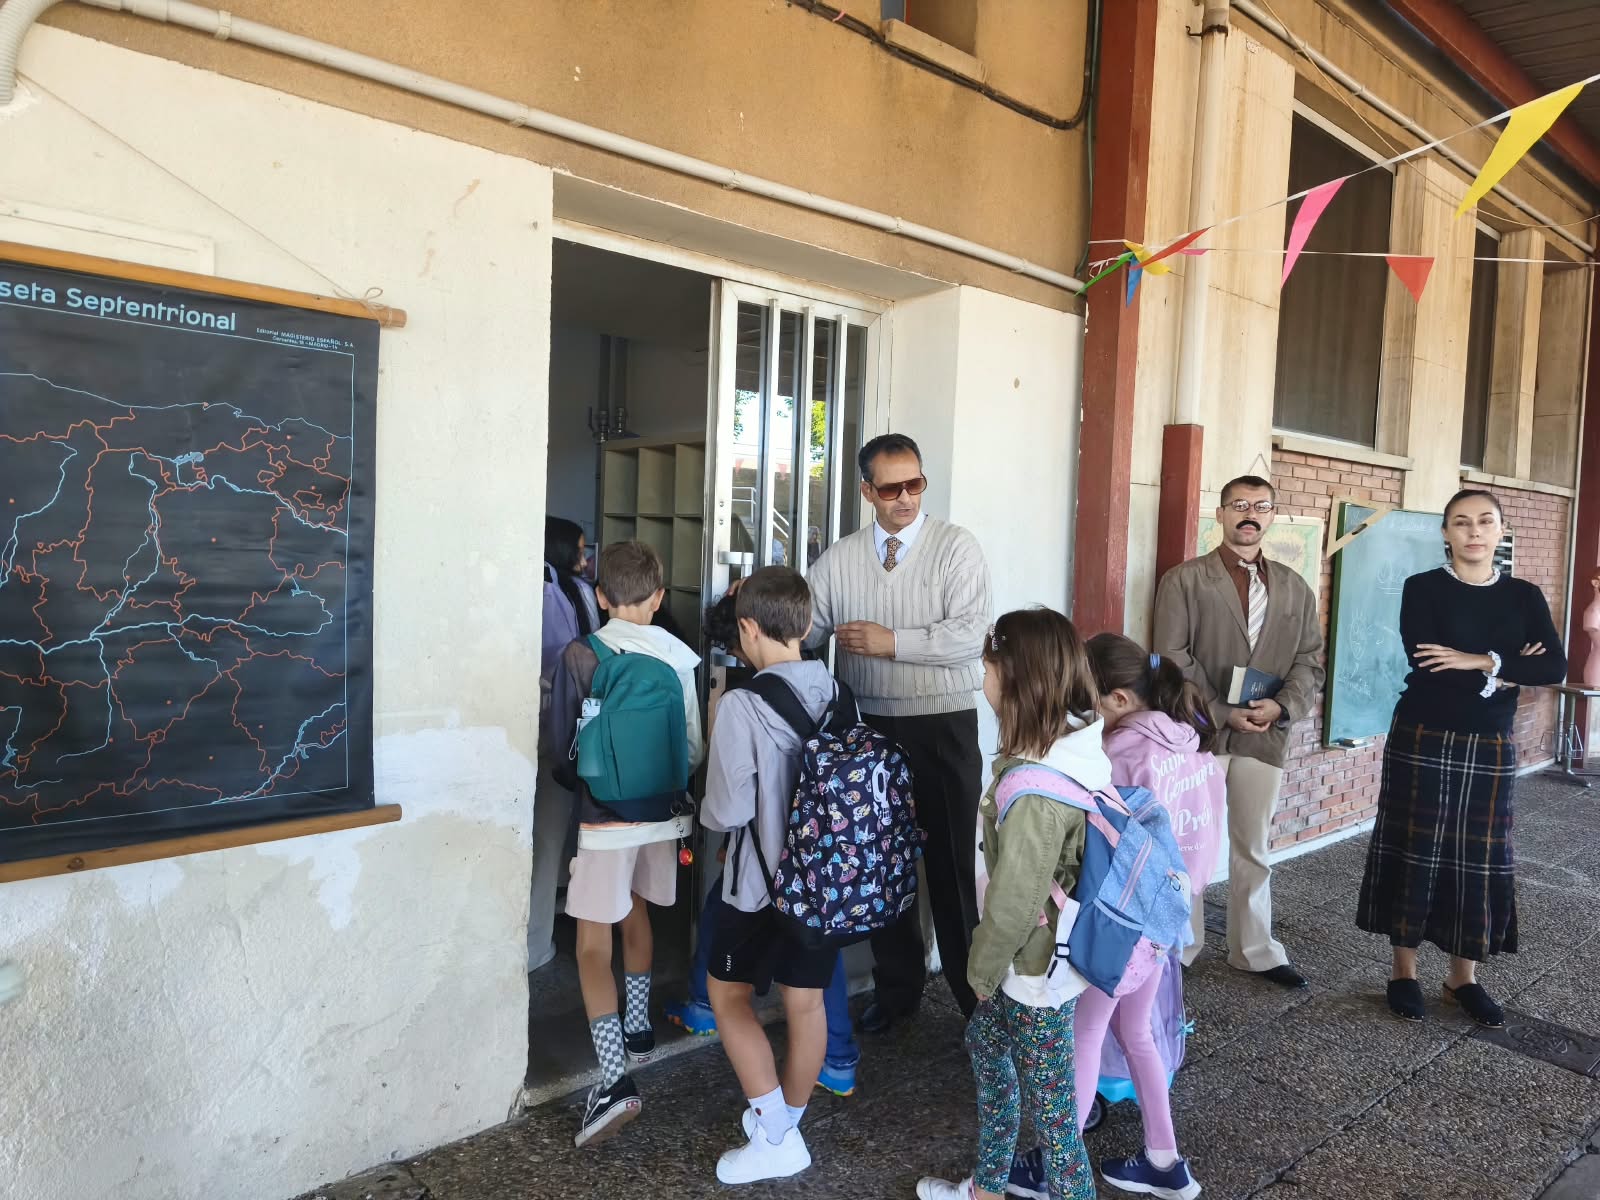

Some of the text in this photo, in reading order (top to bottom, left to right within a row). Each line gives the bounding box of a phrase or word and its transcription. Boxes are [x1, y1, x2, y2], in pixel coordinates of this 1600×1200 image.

[66, 288, 236, 331] Septentrional
[256, 327, 278, 336] Editorial
[280, 331, 315, 342] MAGISTERIO
